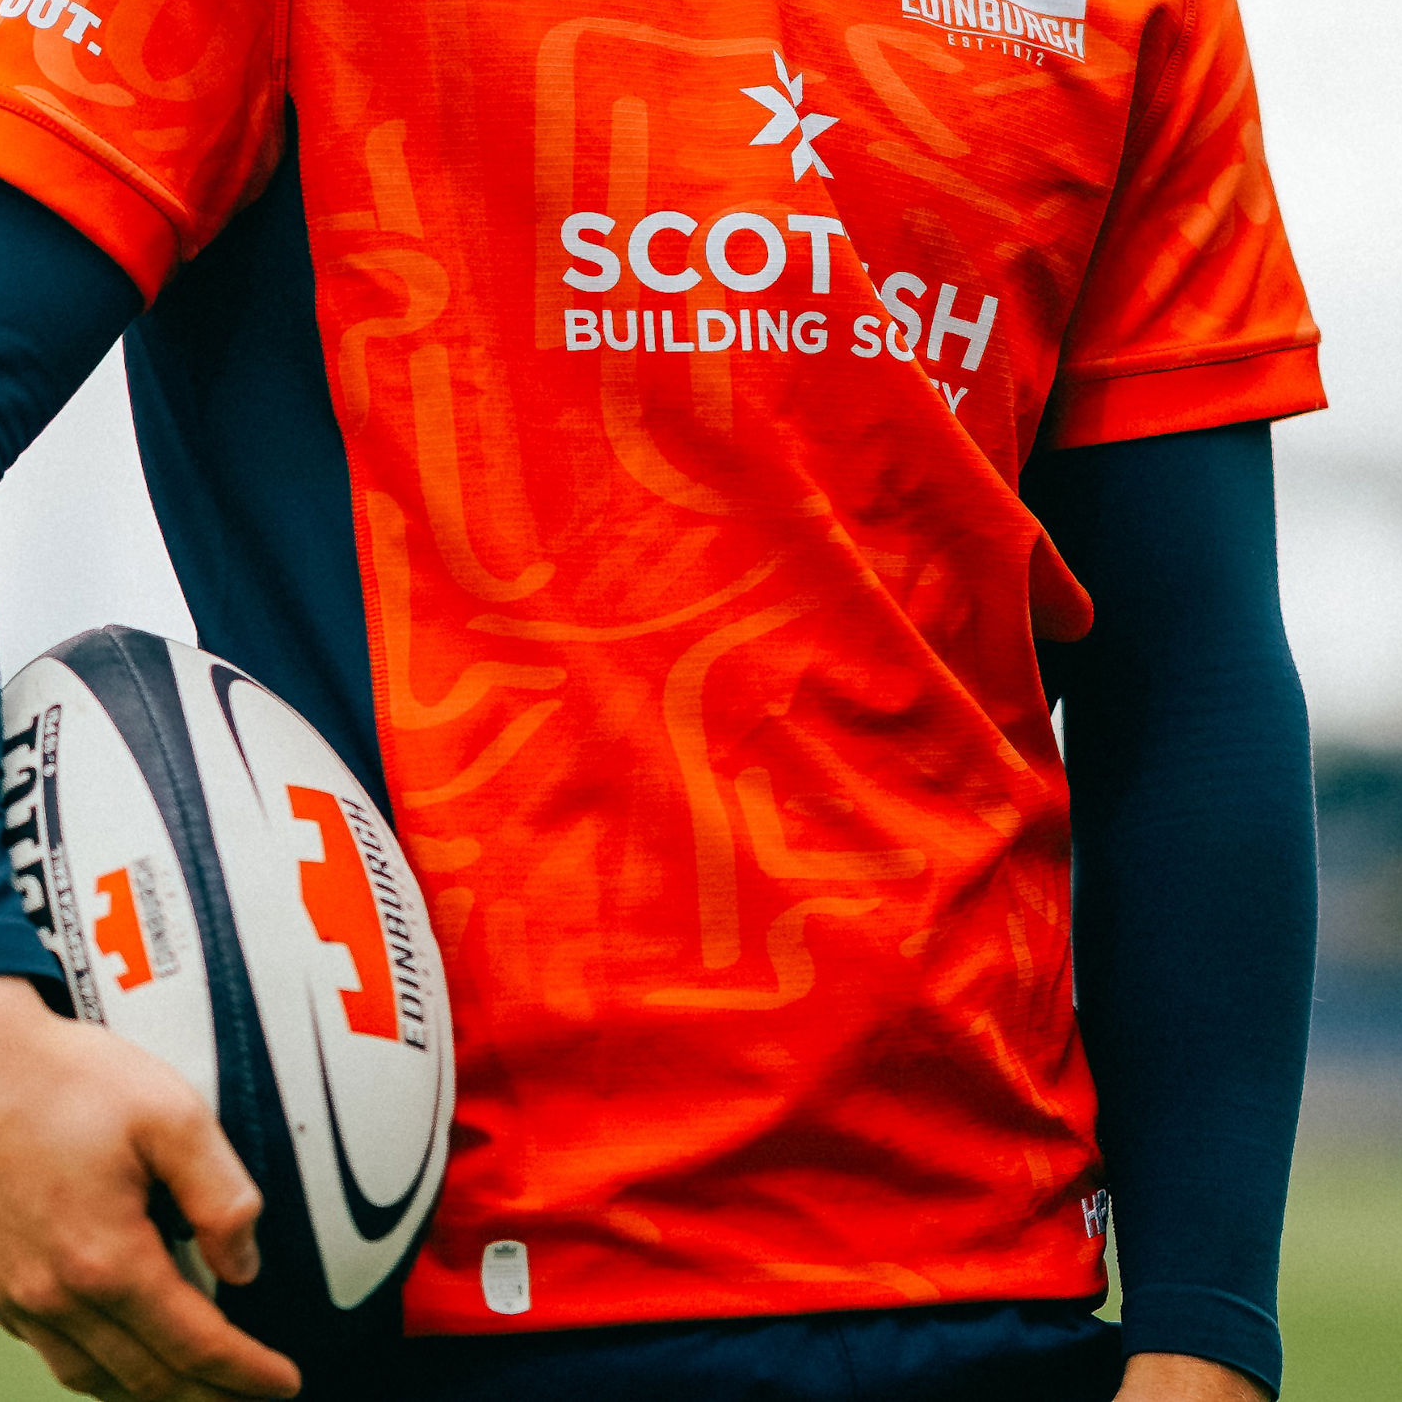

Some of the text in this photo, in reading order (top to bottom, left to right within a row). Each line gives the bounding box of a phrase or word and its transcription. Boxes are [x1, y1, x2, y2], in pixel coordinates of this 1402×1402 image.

[560, 210, 999, 372] SCOTSH
[563, 309, 829, 355] BUILDING
[342, 795, 428, 1053] EDINBURGH
